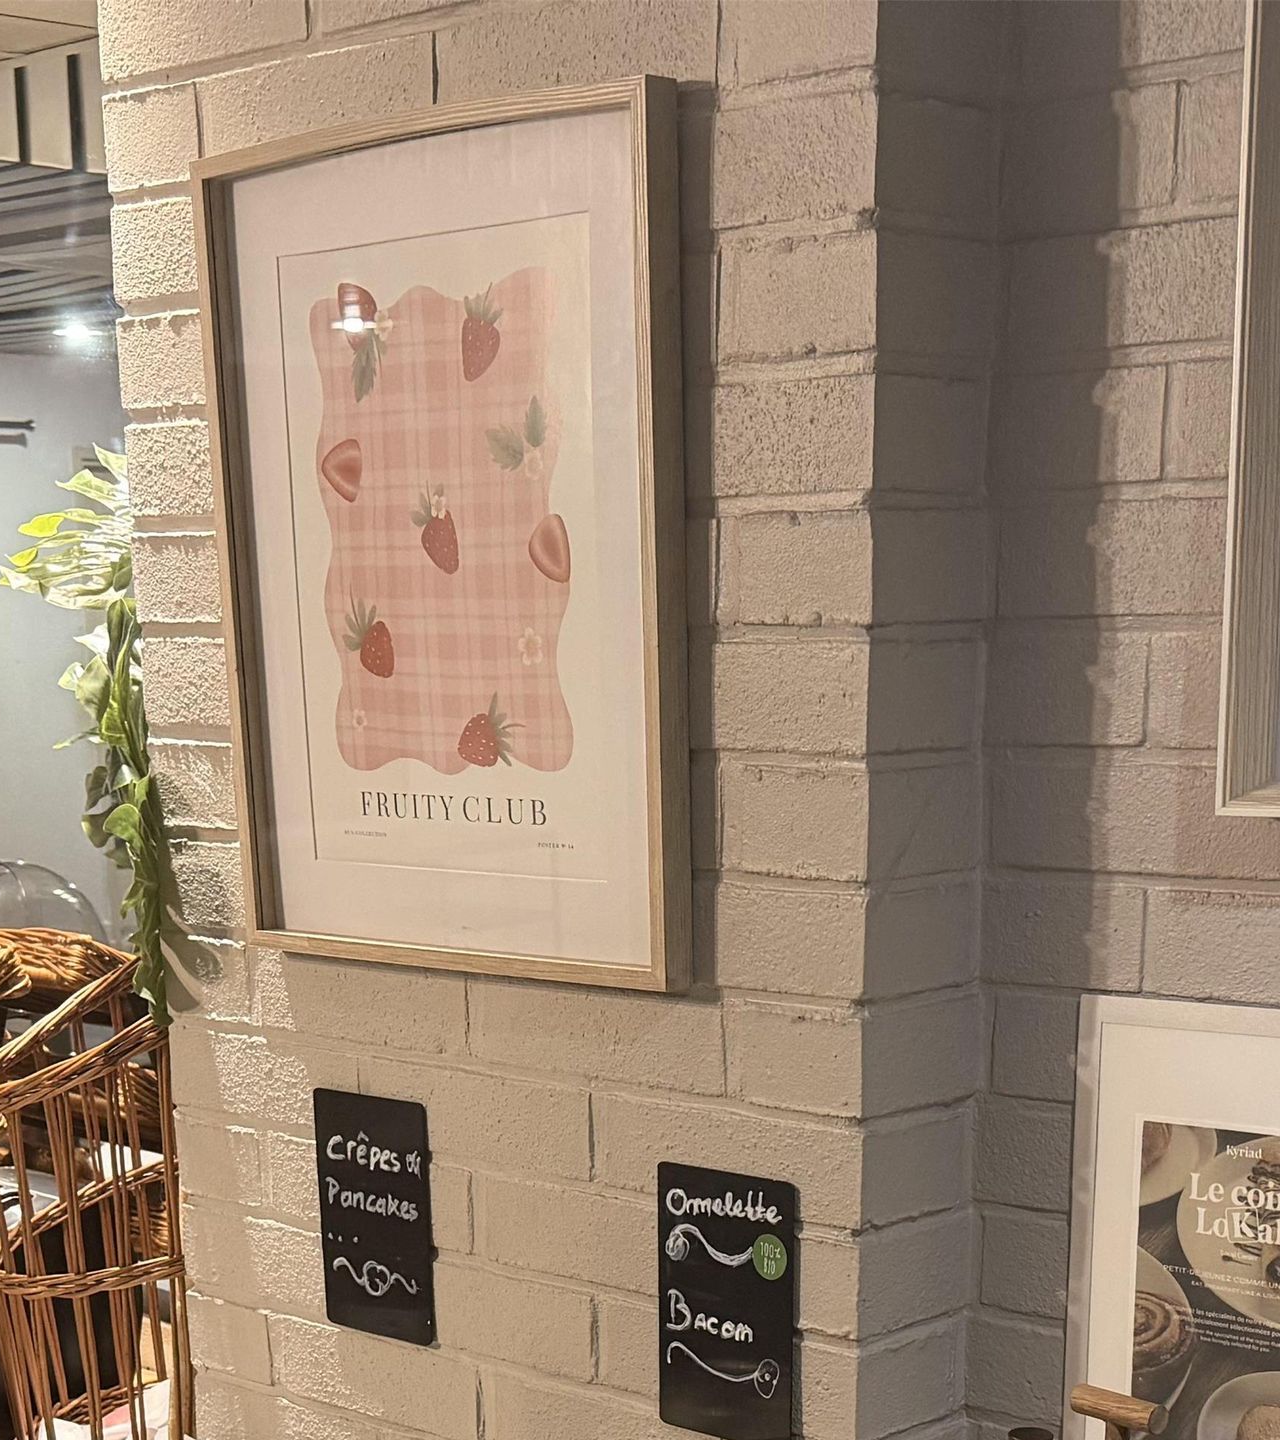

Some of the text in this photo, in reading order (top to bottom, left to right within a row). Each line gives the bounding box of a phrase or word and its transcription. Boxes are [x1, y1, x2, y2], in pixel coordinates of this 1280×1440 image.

[360, 791, 548, 826] FRUITY CLUB
[326, 1130, 401, 1173] Crêpes
[1226, 1144, 1263, 1160] Kyriad
[325, 1176, 419, 1223] Pancakes
[1188, 1172, 1225, 1203] Le
[760, 1241, 781, 1259] 100%
[763, 1258, 776, 1275] BIO
